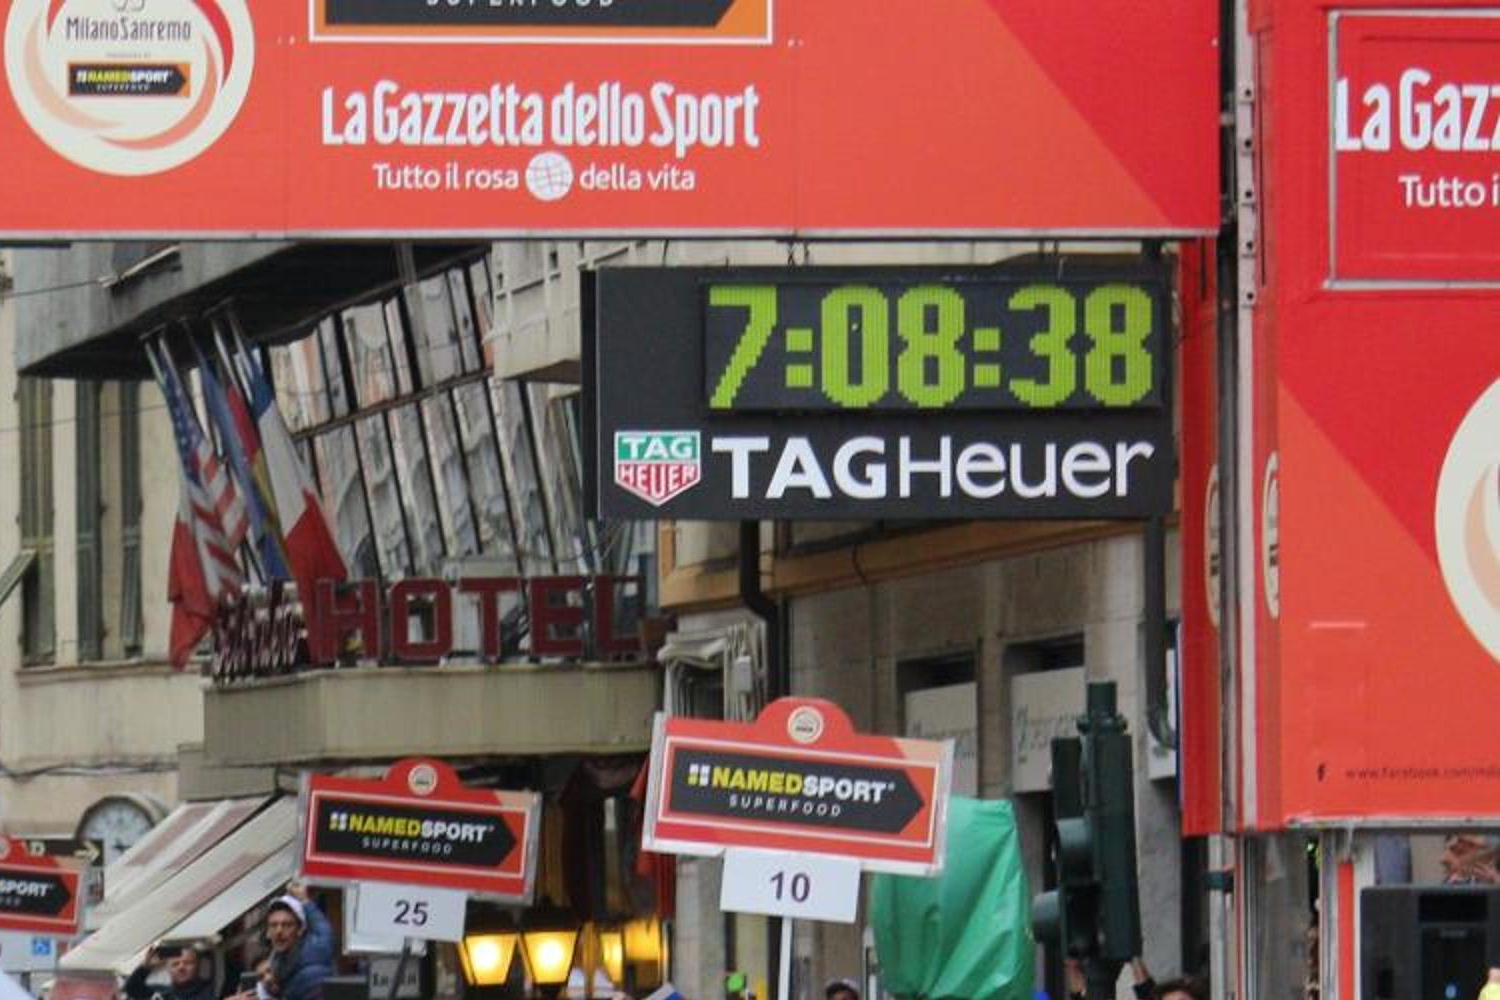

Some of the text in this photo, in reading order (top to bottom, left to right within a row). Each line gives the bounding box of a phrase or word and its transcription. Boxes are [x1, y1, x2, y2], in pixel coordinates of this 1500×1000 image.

[66, 16, 192, 41] MilanoSanremo
[373, 79, 544, 146] Gazzetta
[551, 81, 644, 146] dello
[649, 82, 760, 158] Sport
[1399, 67, 1500, 151] Gaz
[372, 162, 696, 190] Tutto il rosa della vita
[1399, 172, 1486, 208] Tutto
[708, 284, 1154, 409] 7:08:38
[621, 436, 694, 458] TAG
[617, 463, 698, 498] HEUER
[316, 575, 645, 666] HOTEL
[711, 766, 890, 805] NAMEDSPORT
[728, 794, 843, 818] SUPERFOOD
[349, 815, 488, 843] NAMEDSPORT
[769, 871, 812, 904] 10
[393, 899, 430, 927] 25
